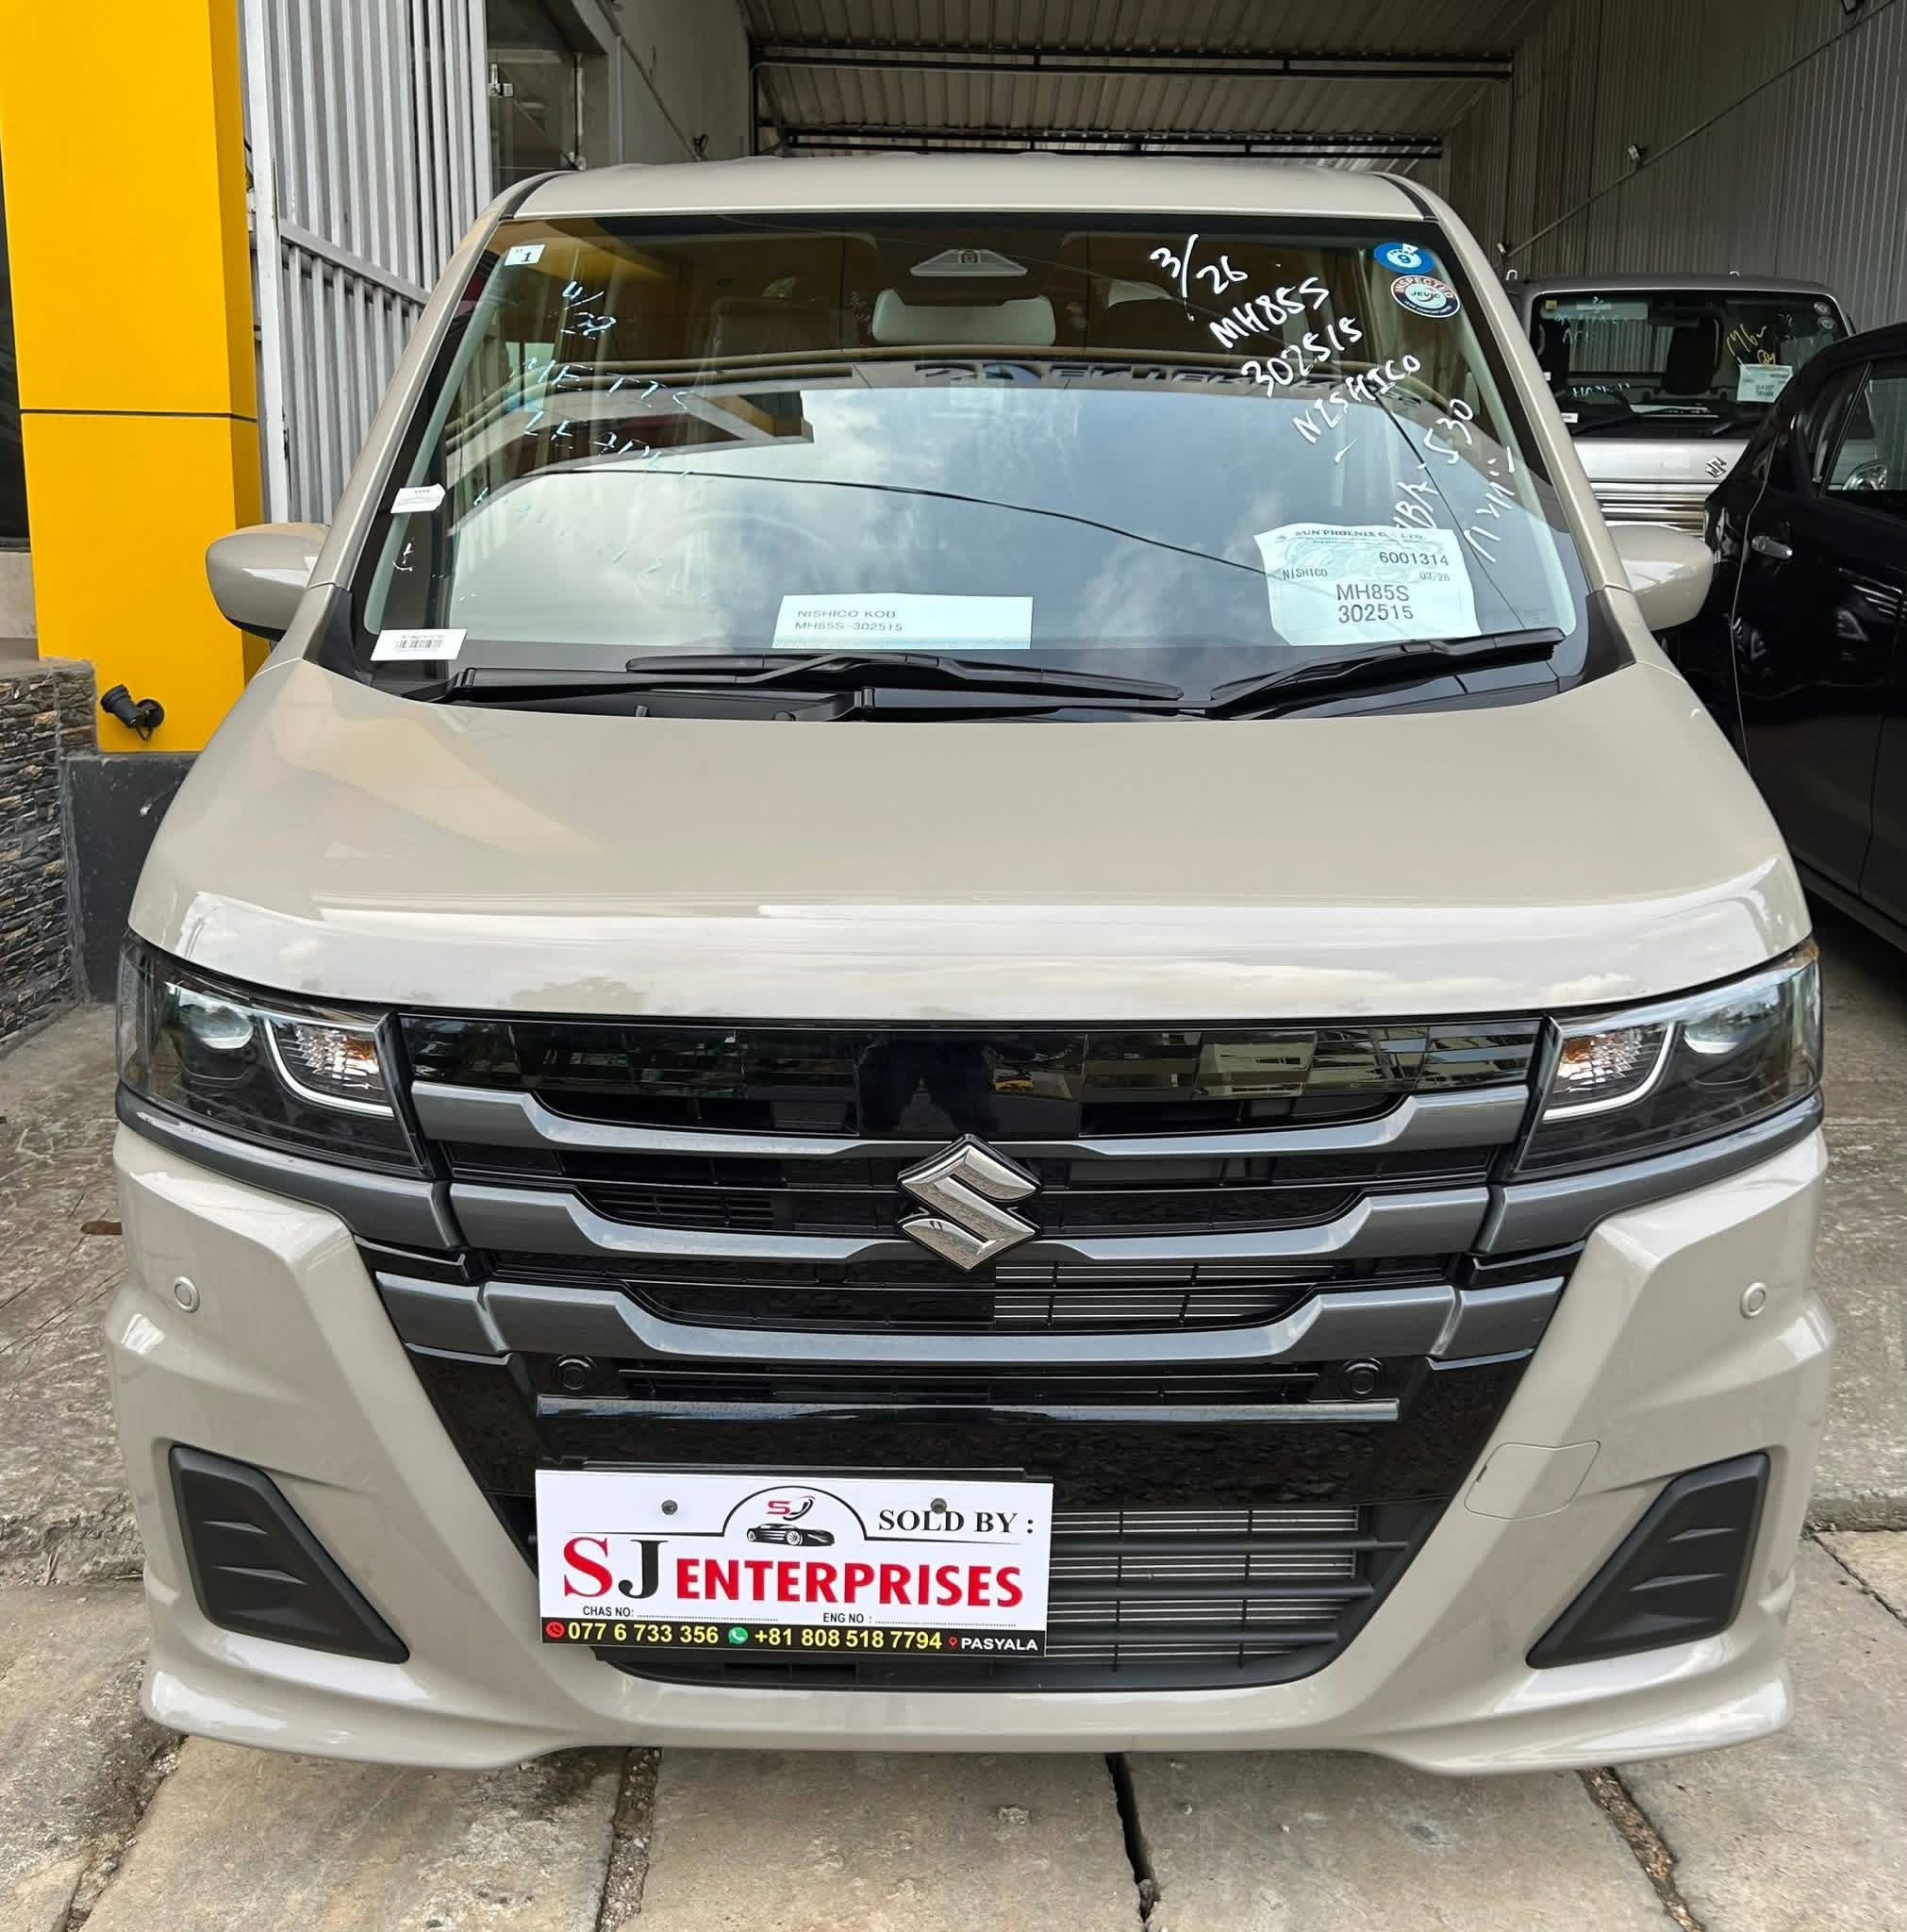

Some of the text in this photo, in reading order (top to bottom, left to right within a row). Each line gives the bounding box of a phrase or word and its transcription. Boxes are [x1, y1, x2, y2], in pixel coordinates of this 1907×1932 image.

[1394, 276, 1454, 300] INSPECTED
[1411, 290, 1441, 299] JEVIC
[1209, 276, 1329, 349] MH85S
[1241, 316, 1363, 398] 302515
[1322, 529, 1374, 538] PHOENIX
[1379, 550, 1450, 567] 6001314
[1282, 567, 1328, 580] NISHICO
[1419, 572, 1451, 582] 03/26
[1335, 584, 1410, 602] MH85S
[797, 609, 859, 619] NISHICO
[1337, 604, 1414, 624] 302515
[794, 621, 904, 632] MH85S-302515
[878, 1508, 965, 1532] SOLD
[973, 1512, 1018, 1533] BY
[676, 1558, 1023, 1607] ENTERPRISES
[583, 1606, 635, 1618] CHAS NO:
[822, 1612, 846, 1624] ENG
[849, 1614, 865, 1624] NO
[568, 1622, 719, 1644] 077 6 733 356
[755, 1627, 942, 1649] +81 808 518 7794
[960, 1637, 1038, 1651] PASYALA
